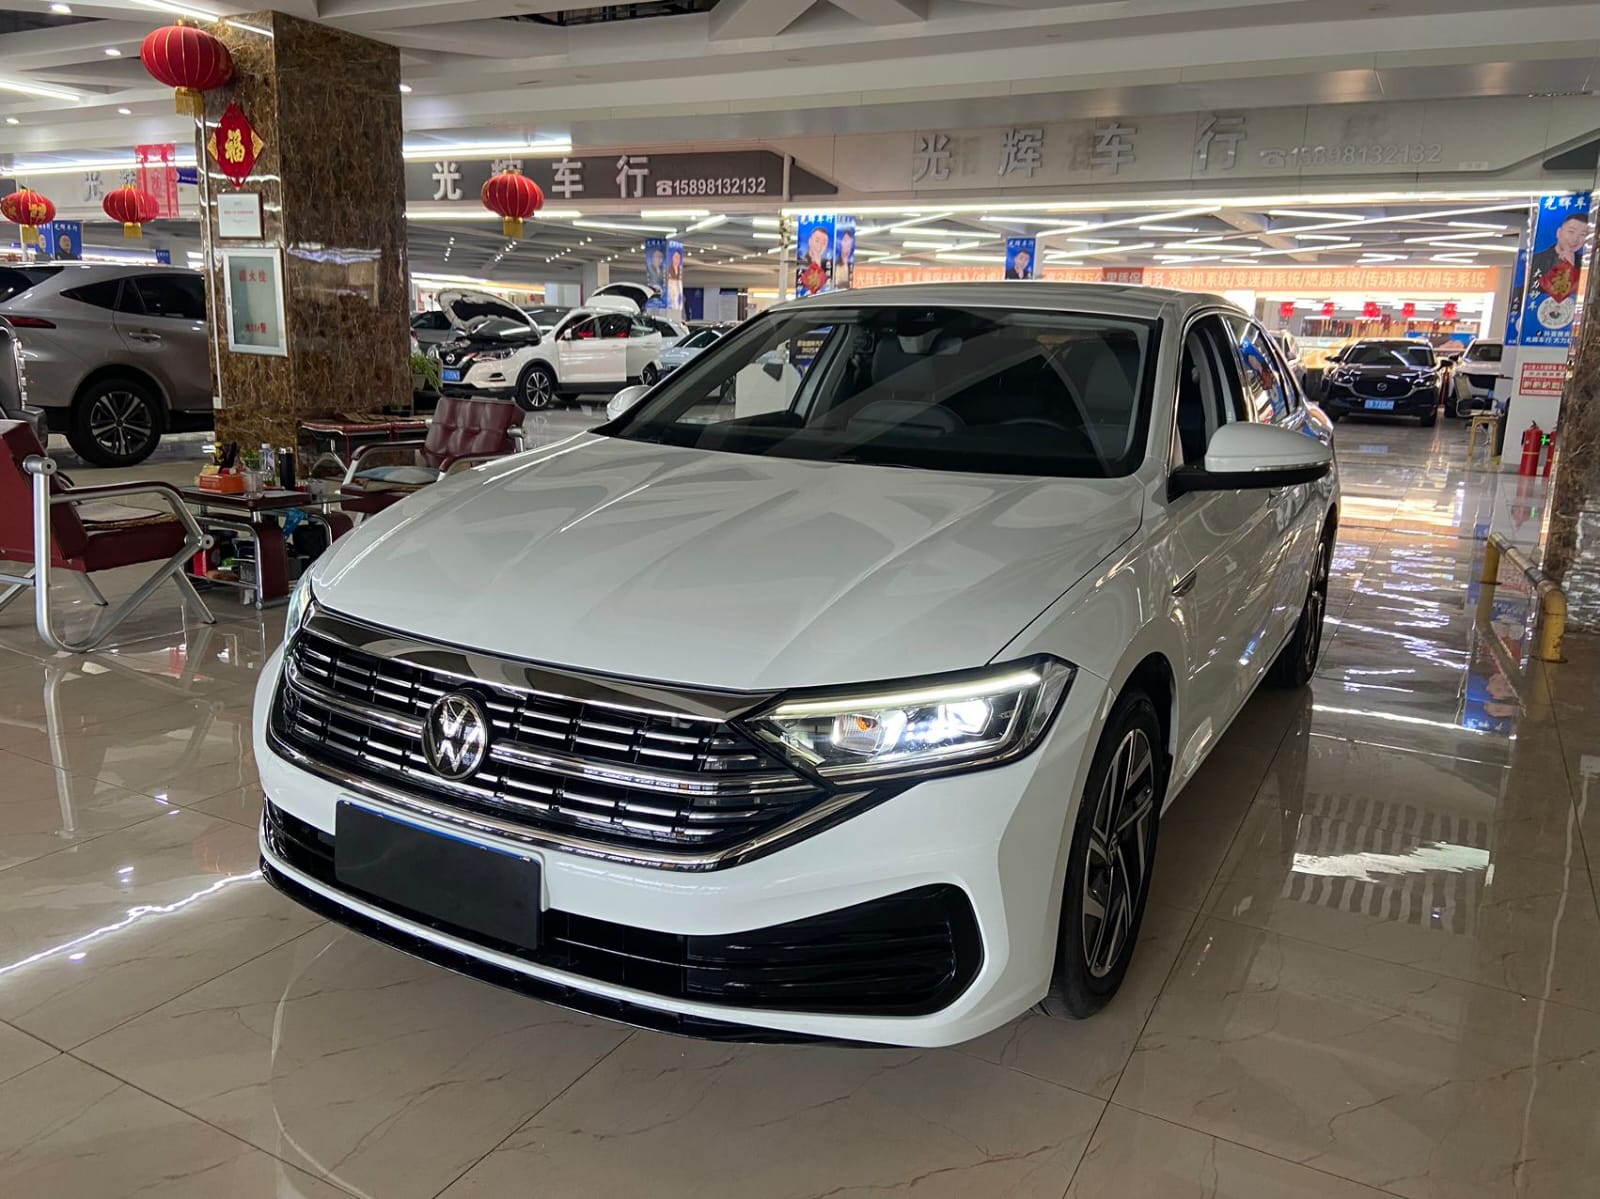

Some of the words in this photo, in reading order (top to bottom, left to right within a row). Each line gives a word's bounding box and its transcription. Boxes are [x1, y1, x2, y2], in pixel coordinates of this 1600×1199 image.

[913, 117, 1246, 182] 光辉车行
[674, 177, 766, 195] 15898132132
